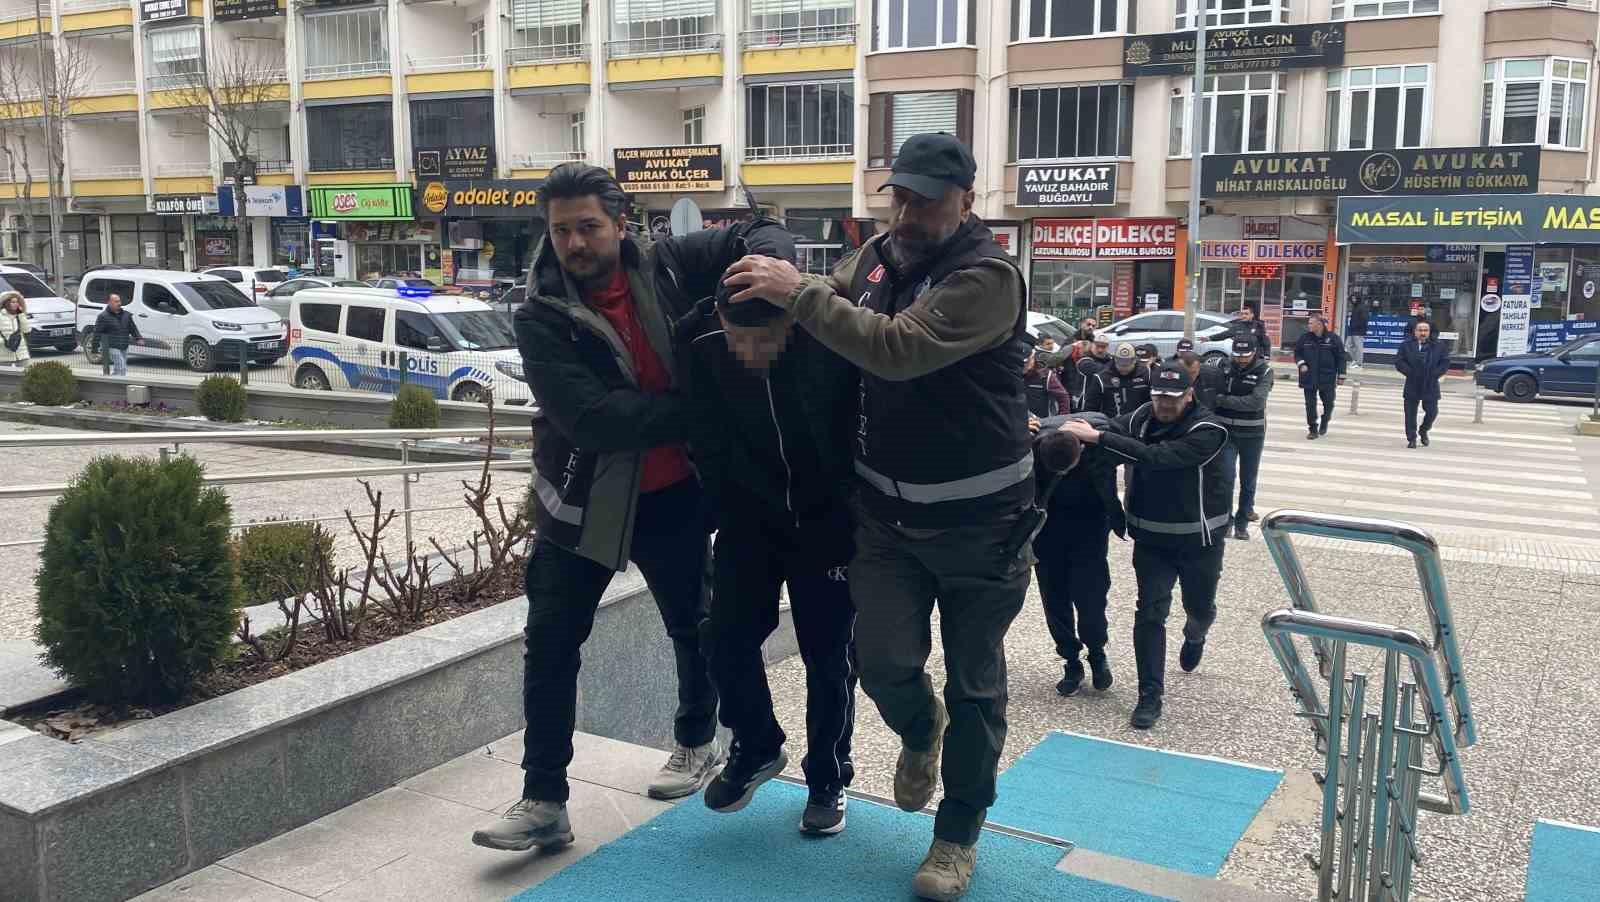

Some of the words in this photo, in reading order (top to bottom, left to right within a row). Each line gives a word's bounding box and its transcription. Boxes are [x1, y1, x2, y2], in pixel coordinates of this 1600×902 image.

[1214, 30, 1250, 38] AVUKAT
[1171, 38, 1228, 51] MUAT
[446, 147, 488, 160] AYVAZ
[640, 148, 664, 158] HUKUK
[645, 158, 690, 169] AVUKAT
[1232, 156, 1331, 175] AVUKAT
[1412, 151, 1524, 170] AVUKAT
[627, 170, 667, 181] BURAK
[670, 168, 709, 181] ÖLÇER
[1025, 167, 1111, 182] AVUKAT
[1404, 173, 1462, 189] HÜSEYİN
[1466, 171, 1529, 188] GÖKKAYA
[1025, 184, 1058, 193] YAVUZ
[1060, 182, 1109, 192] BAHADIR
[1215, 178, 1252, 193] NİHAT
[1255, 176, 1347, 192] AHISKALIOĞLU
[454, 188, 509, 205] adalet
[1039, 193, 1093, 203] BUĞDAYLI
[1351, 211, 1428, 227] MASAL
[1433, 207, 1524, 230] İLETİŞİM
[1034, 247, 1063, 256] ARZUHAL
[1099, 247, 1138, 256] ARZUHAL
[1503, 300, 1528, 309] FATURA
[402, 356, 438, 374] OLİS
